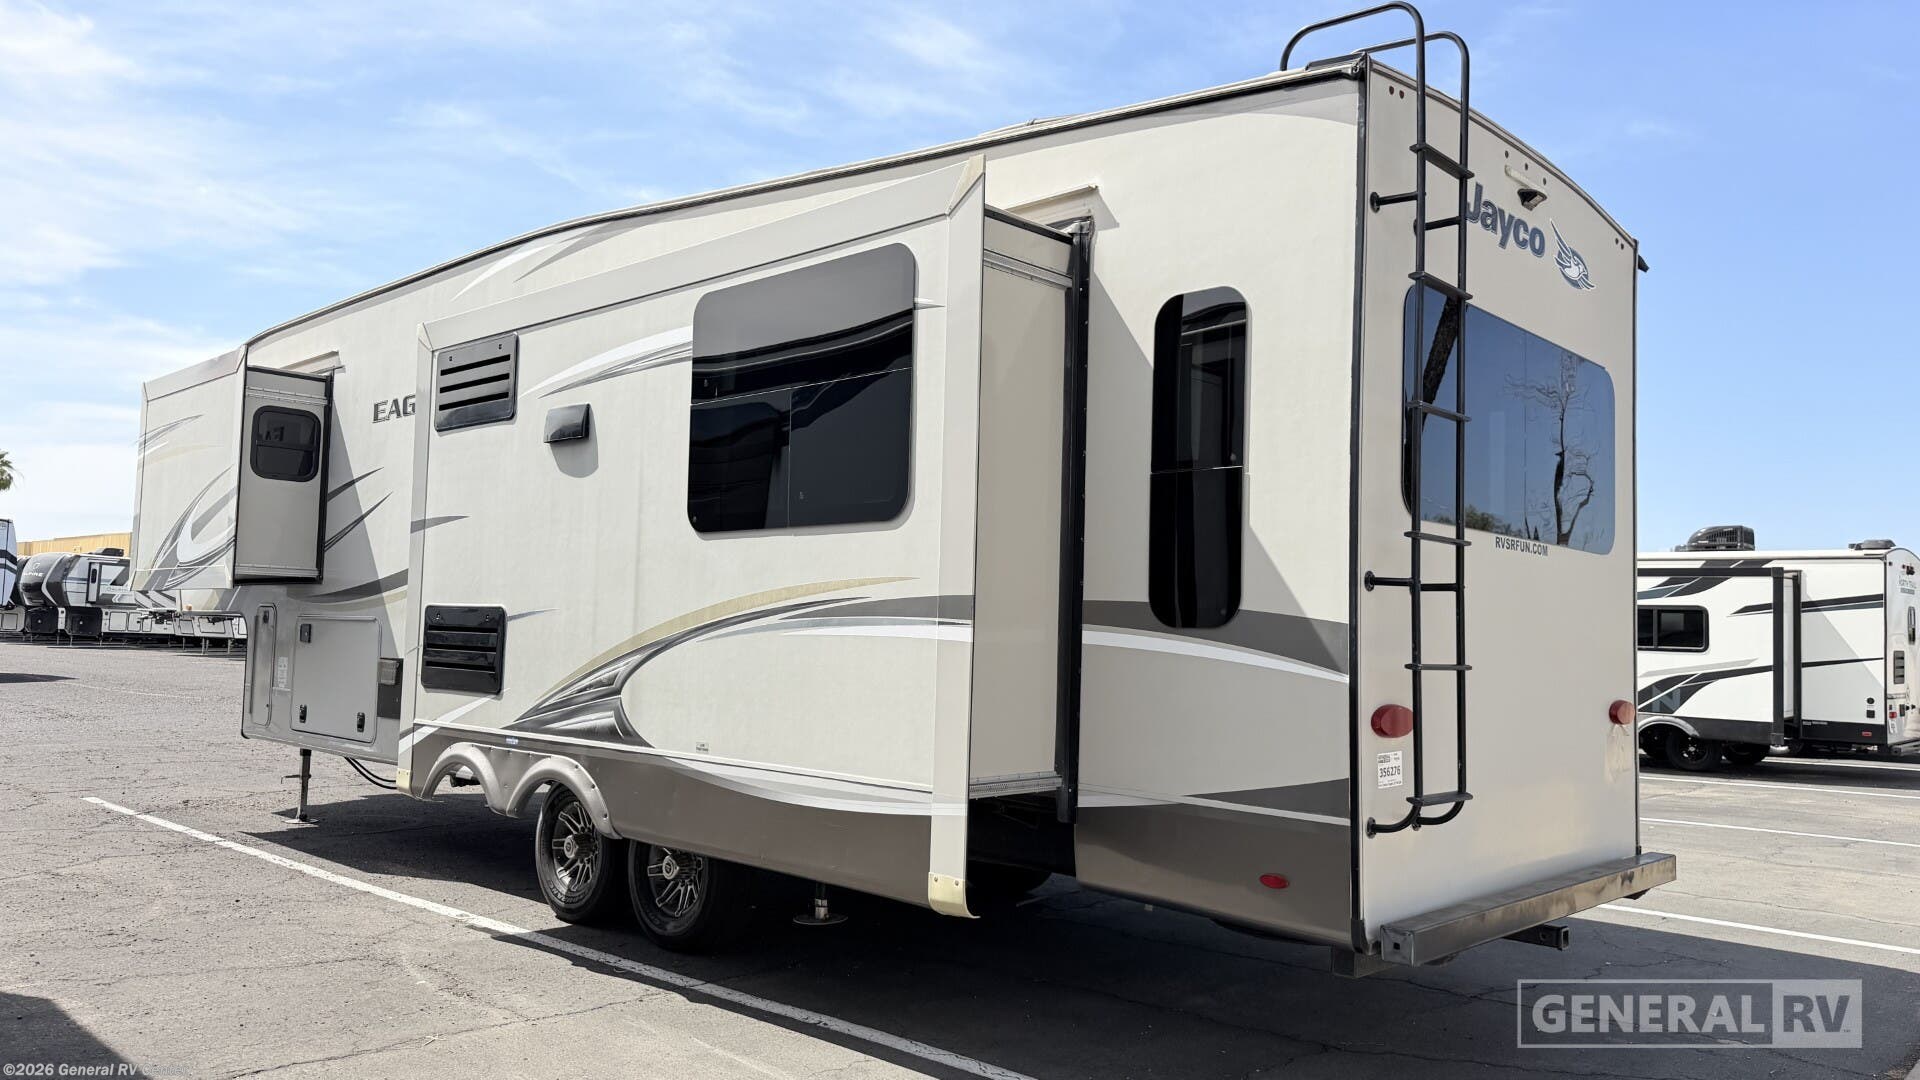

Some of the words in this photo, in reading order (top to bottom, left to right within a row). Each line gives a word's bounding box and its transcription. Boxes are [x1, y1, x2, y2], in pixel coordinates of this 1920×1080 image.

[1466, 182, 1545, 257] Jayco
[1495, 536, 1548, 556] RVSRFUN.COM
[1379, 765, 1401, 778] 356276
